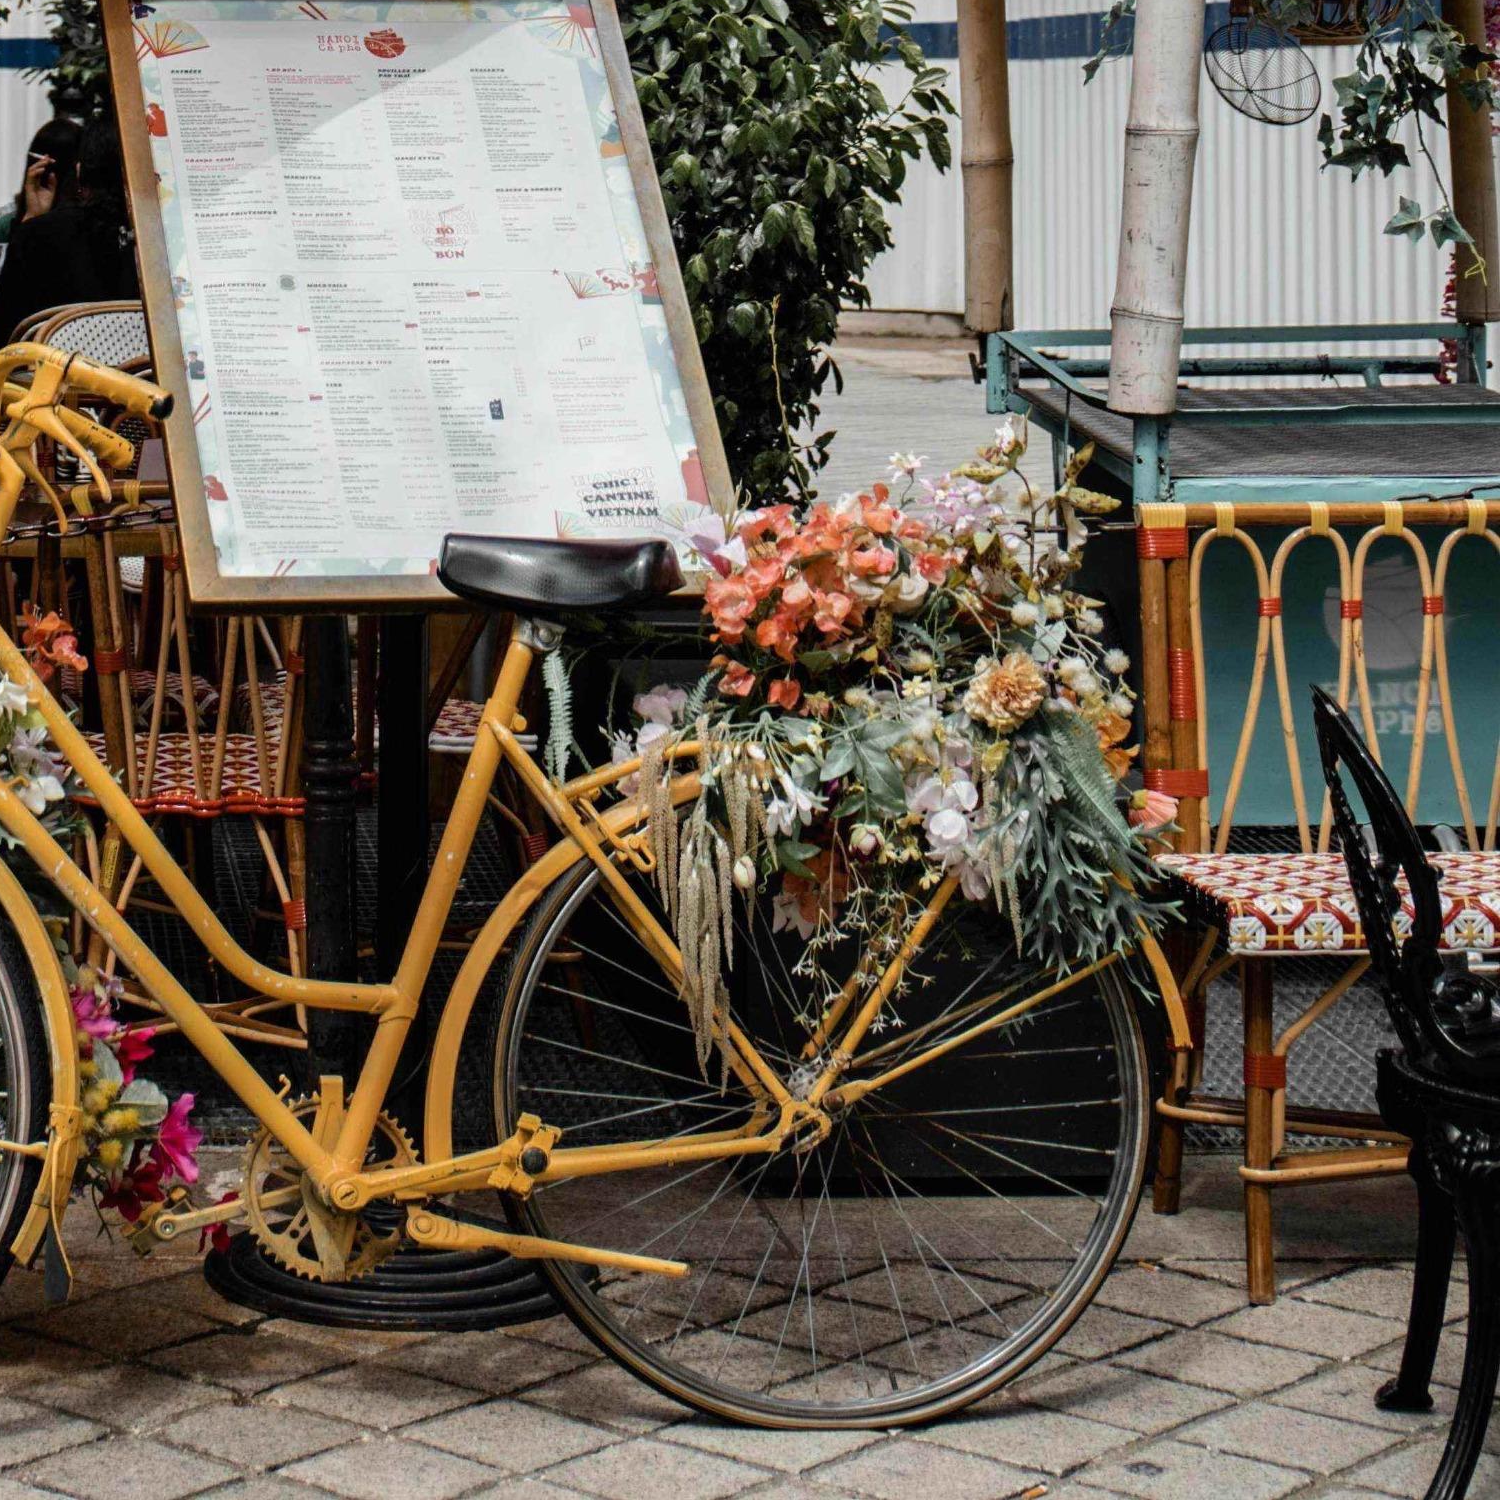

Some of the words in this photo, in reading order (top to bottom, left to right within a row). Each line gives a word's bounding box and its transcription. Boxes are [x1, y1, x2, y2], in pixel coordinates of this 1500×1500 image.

[592, 478, 630, 490] CHIC
[583, 490, 655, 504] CANTINE
[585, 506, 660, 518] VIETNAM
